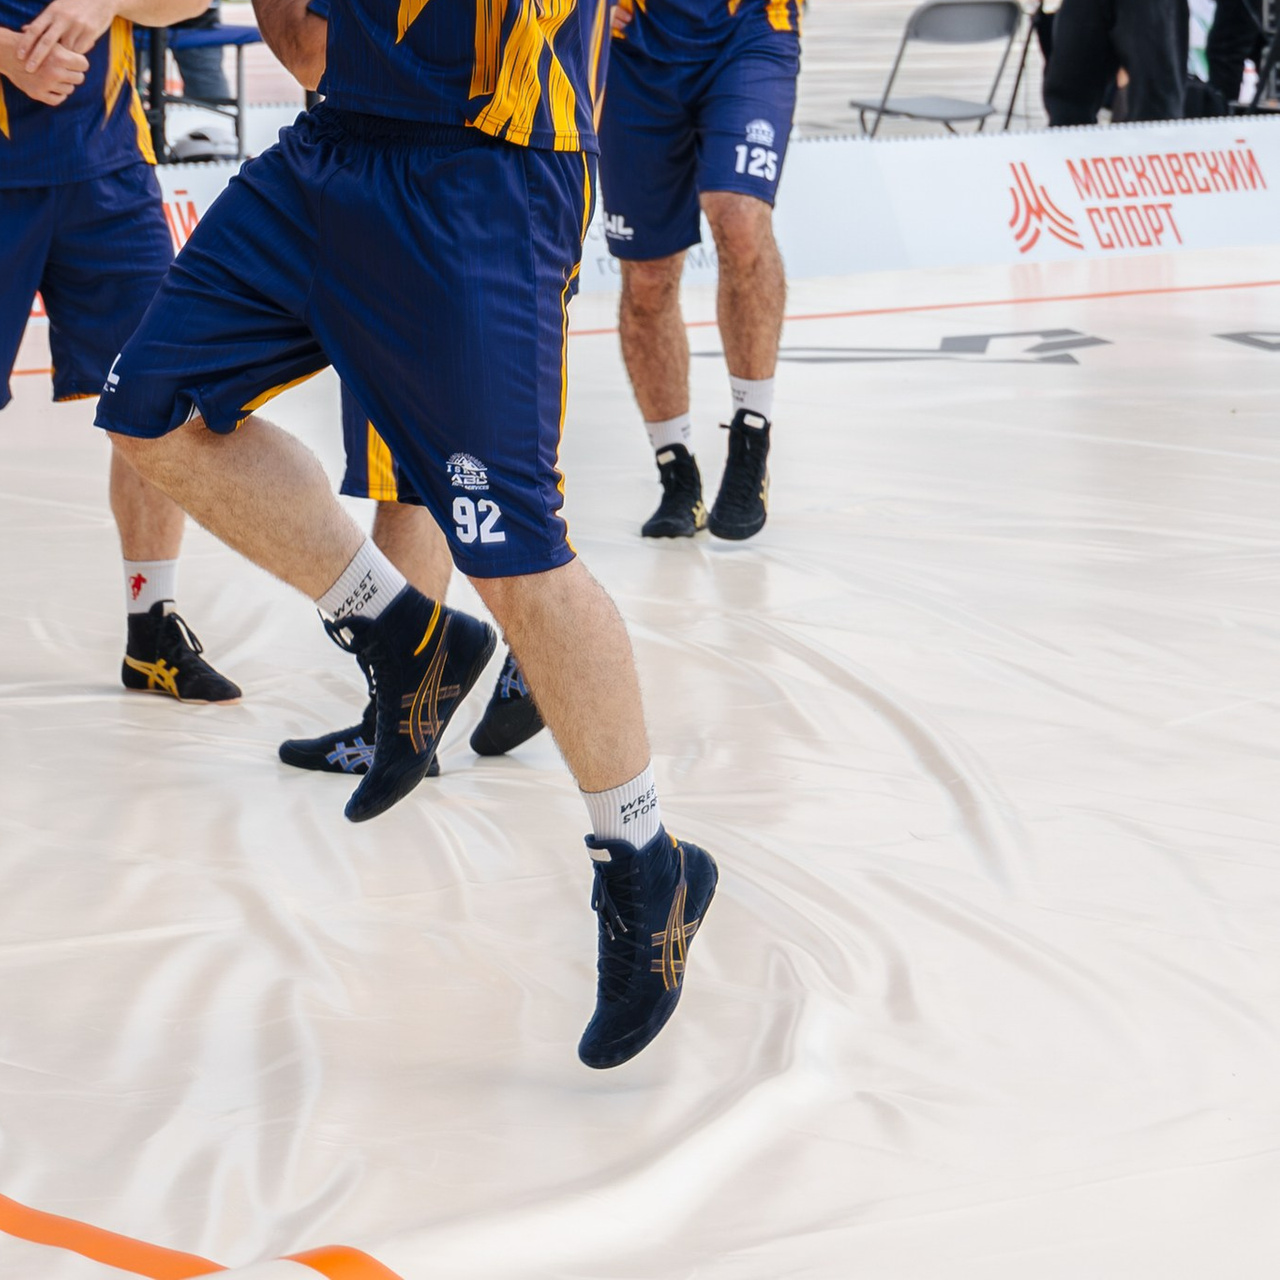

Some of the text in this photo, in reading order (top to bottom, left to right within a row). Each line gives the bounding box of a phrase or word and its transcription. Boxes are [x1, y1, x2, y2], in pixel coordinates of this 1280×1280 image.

[735, 144, 778, 181] 125
[1066, 138, 1268, 201] МОСКОВСКИЙ
[1086, 203, 1183, 250] СПОРТ
[452, 496, 506, 544] 92
[333, 569, 373, 618] WREST
[344, 583, 379, 619] TORE
[620, 782, 655, 814] WRES
[622, 795, 658, 824] STOR
